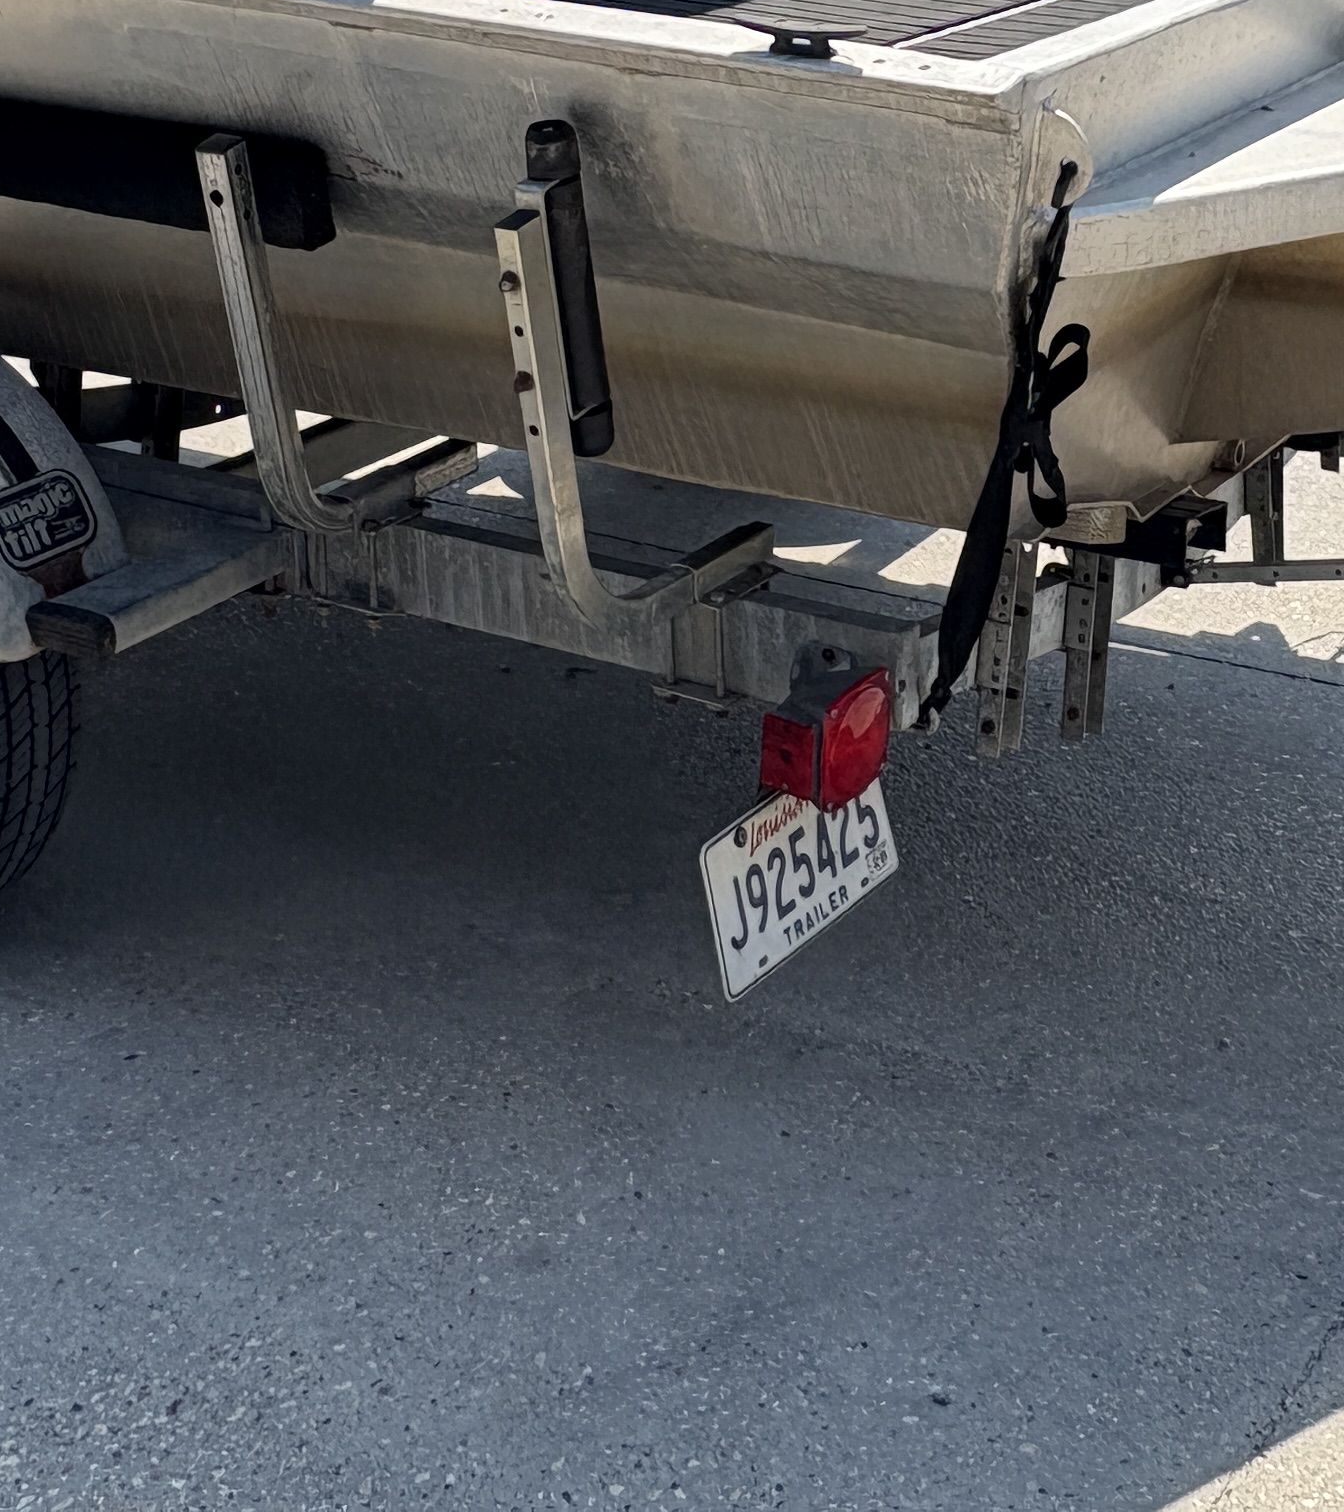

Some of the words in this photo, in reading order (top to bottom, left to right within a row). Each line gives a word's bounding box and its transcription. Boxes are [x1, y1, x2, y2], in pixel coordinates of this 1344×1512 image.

[3, 518, 53, 558] tilt
[730, 795, 880, 951] J925A25
[782, 885, 850, 947] TRAILER
